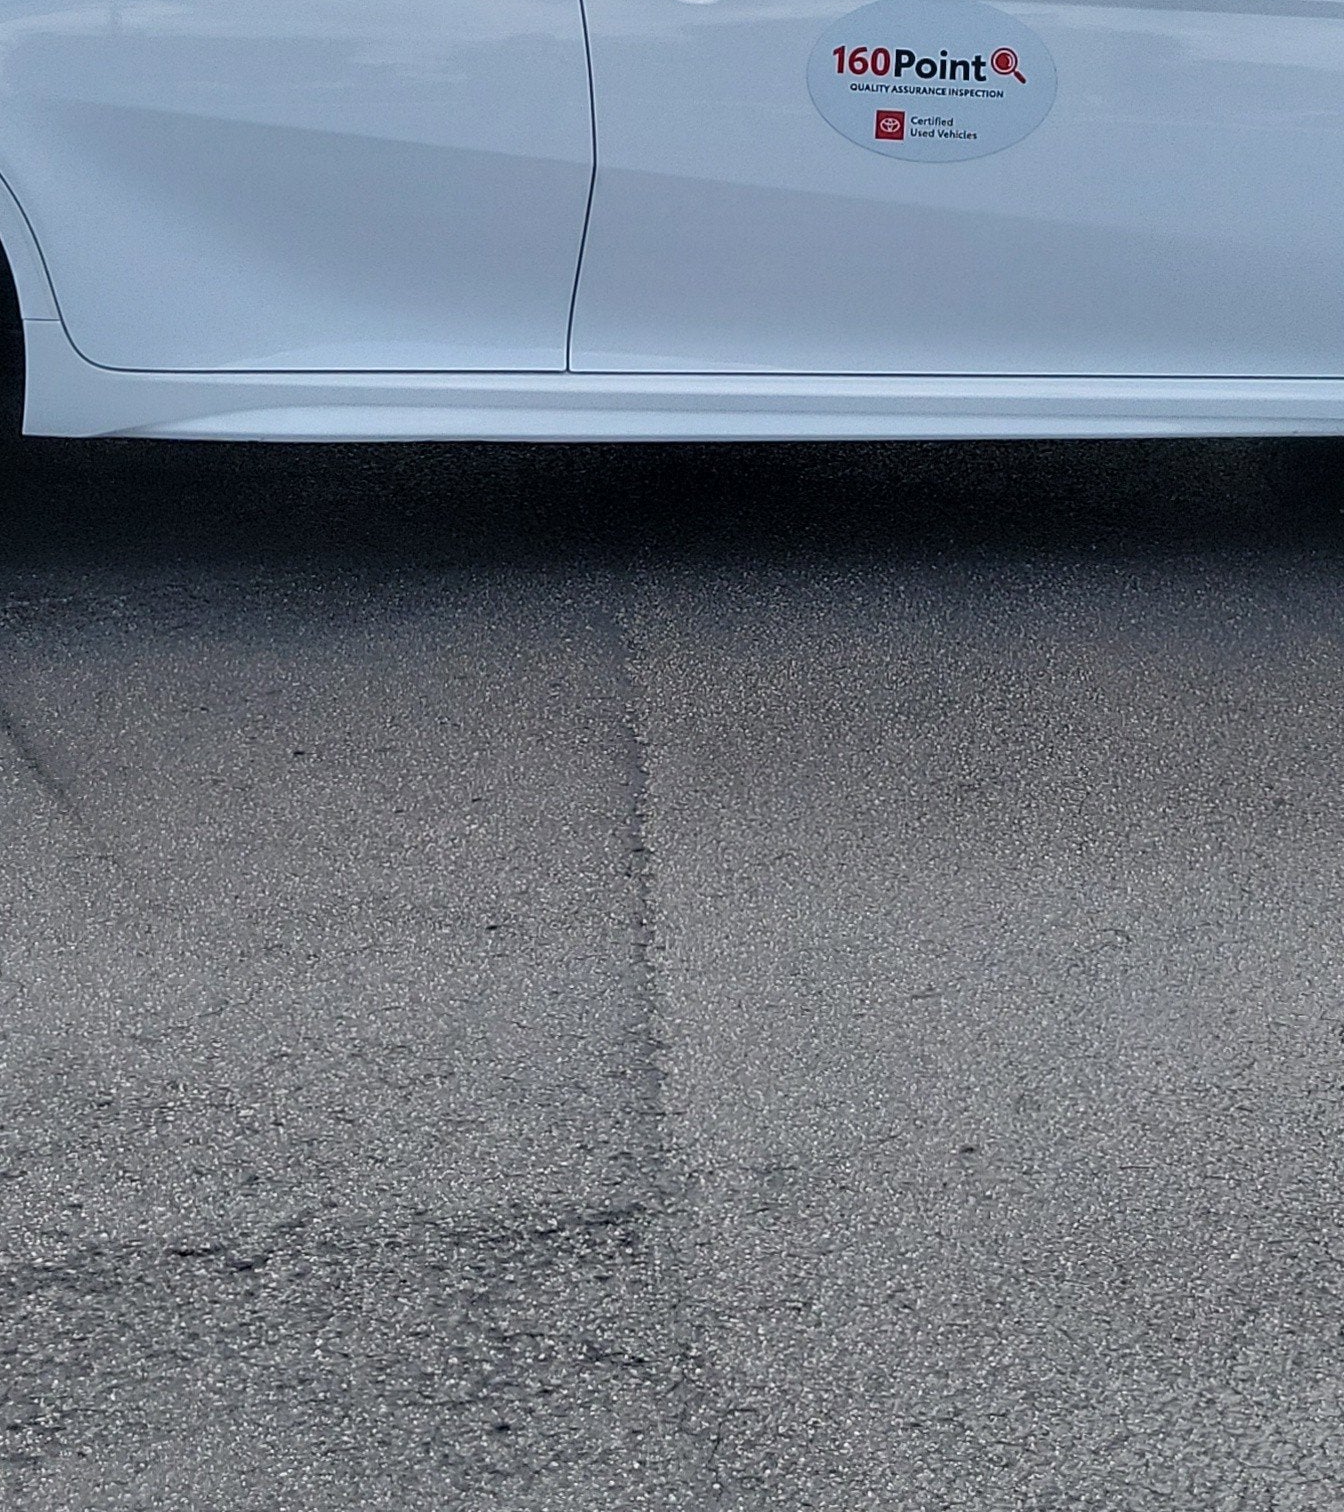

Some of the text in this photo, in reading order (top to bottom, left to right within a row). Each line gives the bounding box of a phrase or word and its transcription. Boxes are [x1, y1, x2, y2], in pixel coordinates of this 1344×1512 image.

[833, 45, 987, 82] 160Point
[849, 82, 1005, 99] QUALITY ASSURANCE INSPECTION
[910, 116, 954, 127] Certified
[910, 129, 978, 140] Used Vehicles
